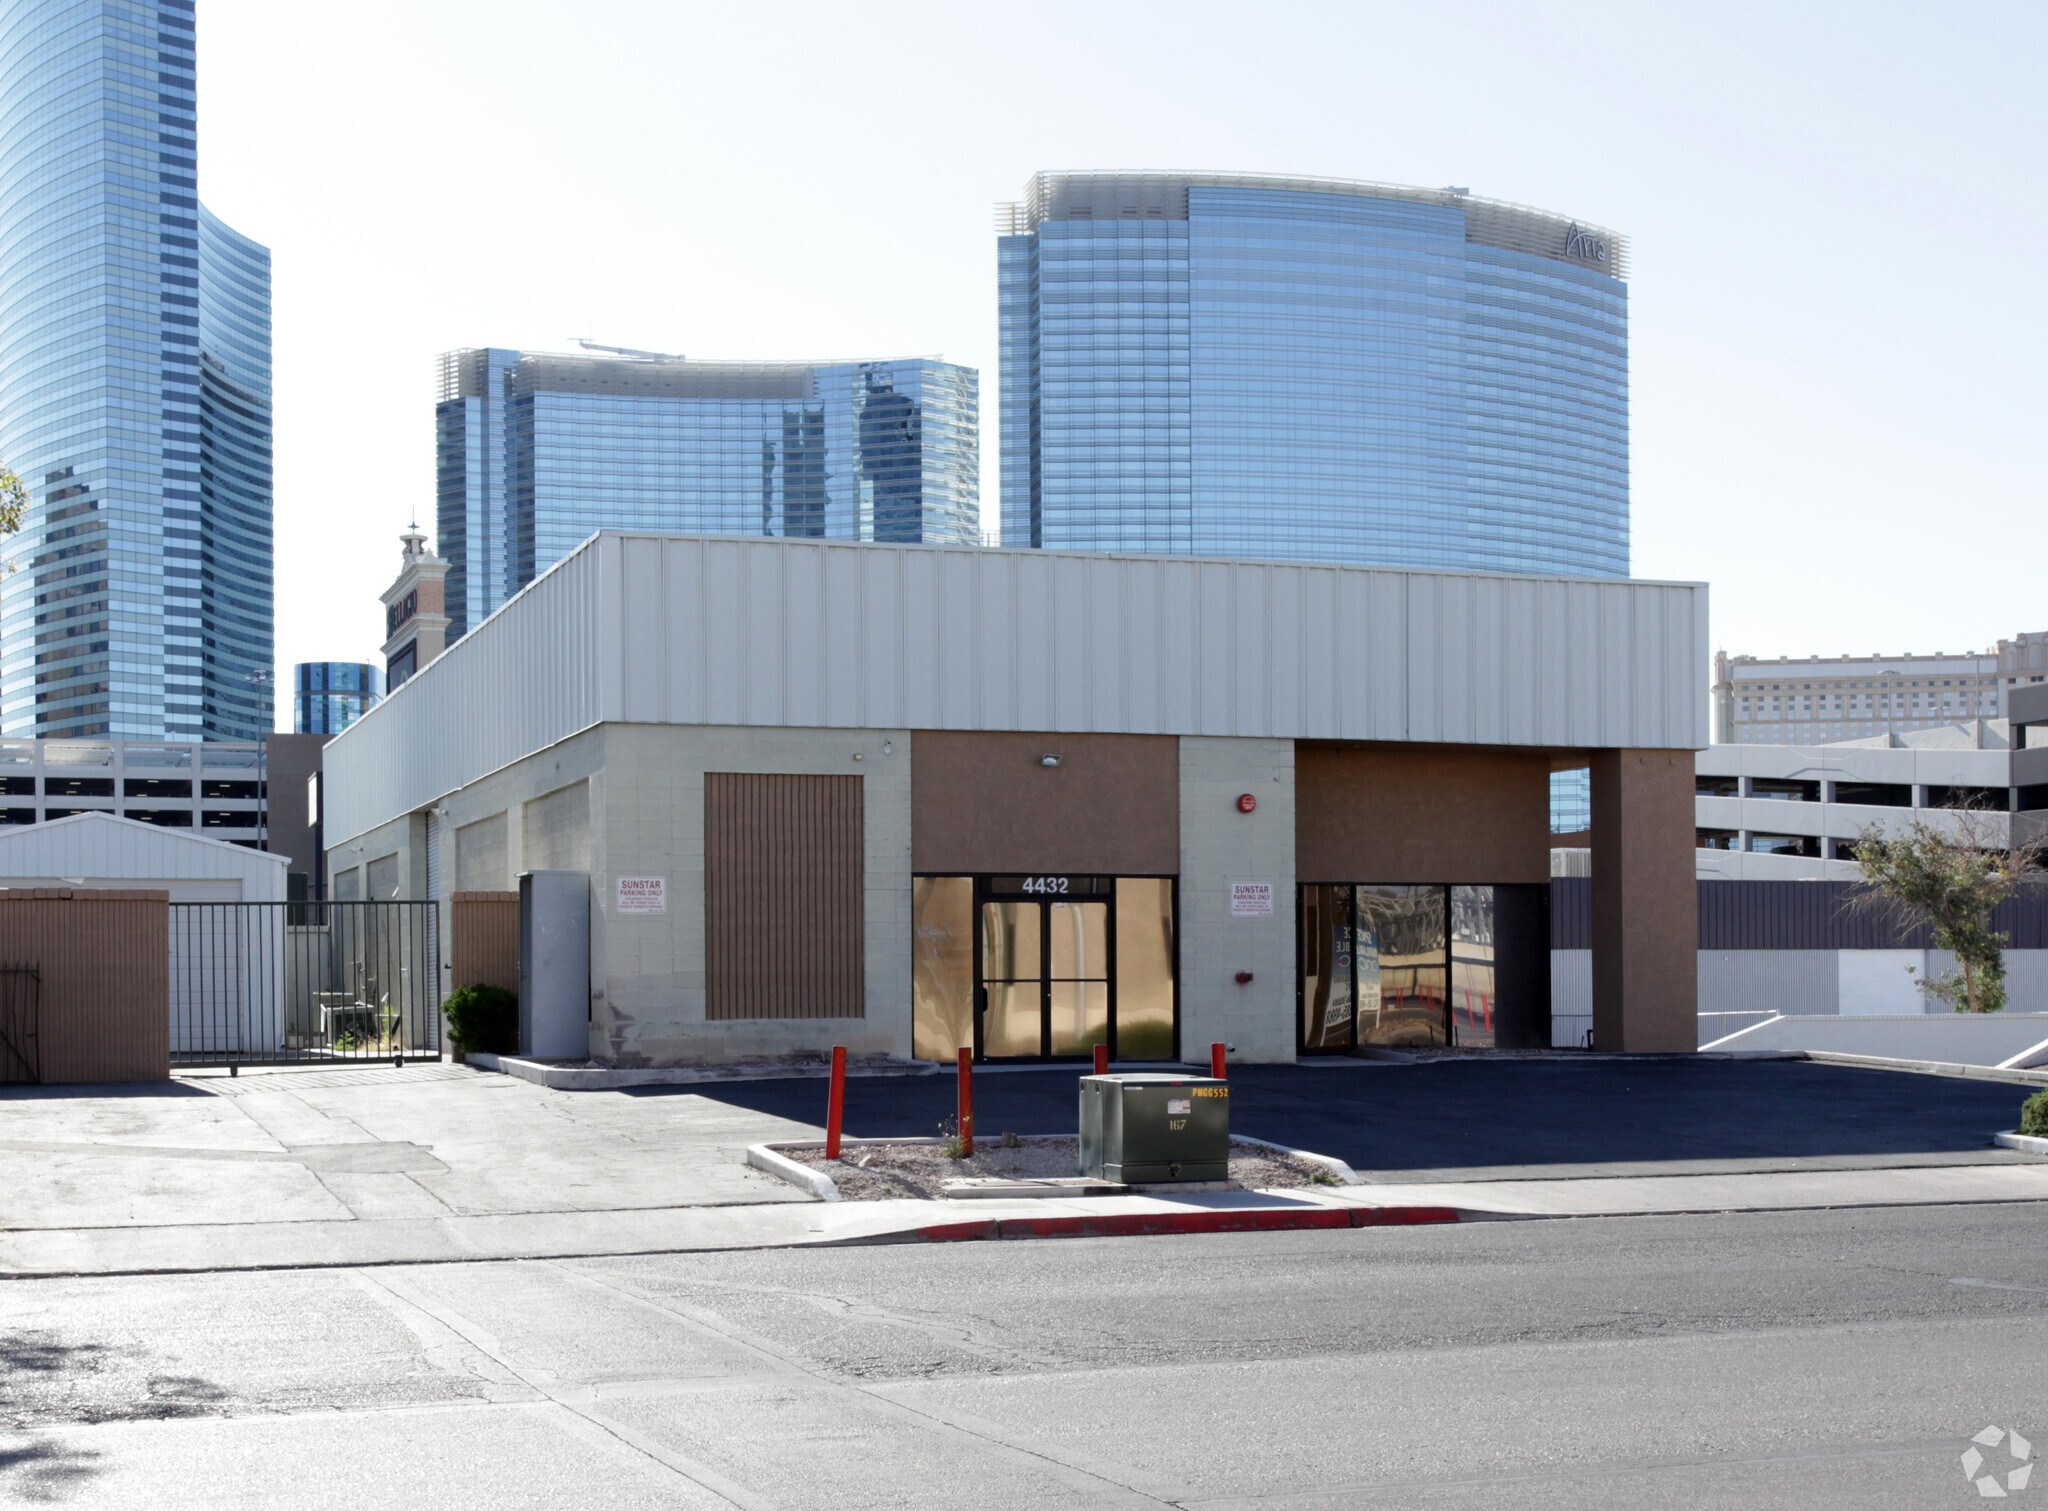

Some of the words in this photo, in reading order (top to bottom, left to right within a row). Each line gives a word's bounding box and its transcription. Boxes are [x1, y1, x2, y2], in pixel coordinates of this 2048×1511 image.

[1565, 221, 1605, 261] Aria
[621, 880, 661, 889] SUNSTAR
[1022, 877, 1069, 894] 4432
[1235, 885, 1269, 894] SUNSTAR
[1169, 1120, 1187, 1131] 167
